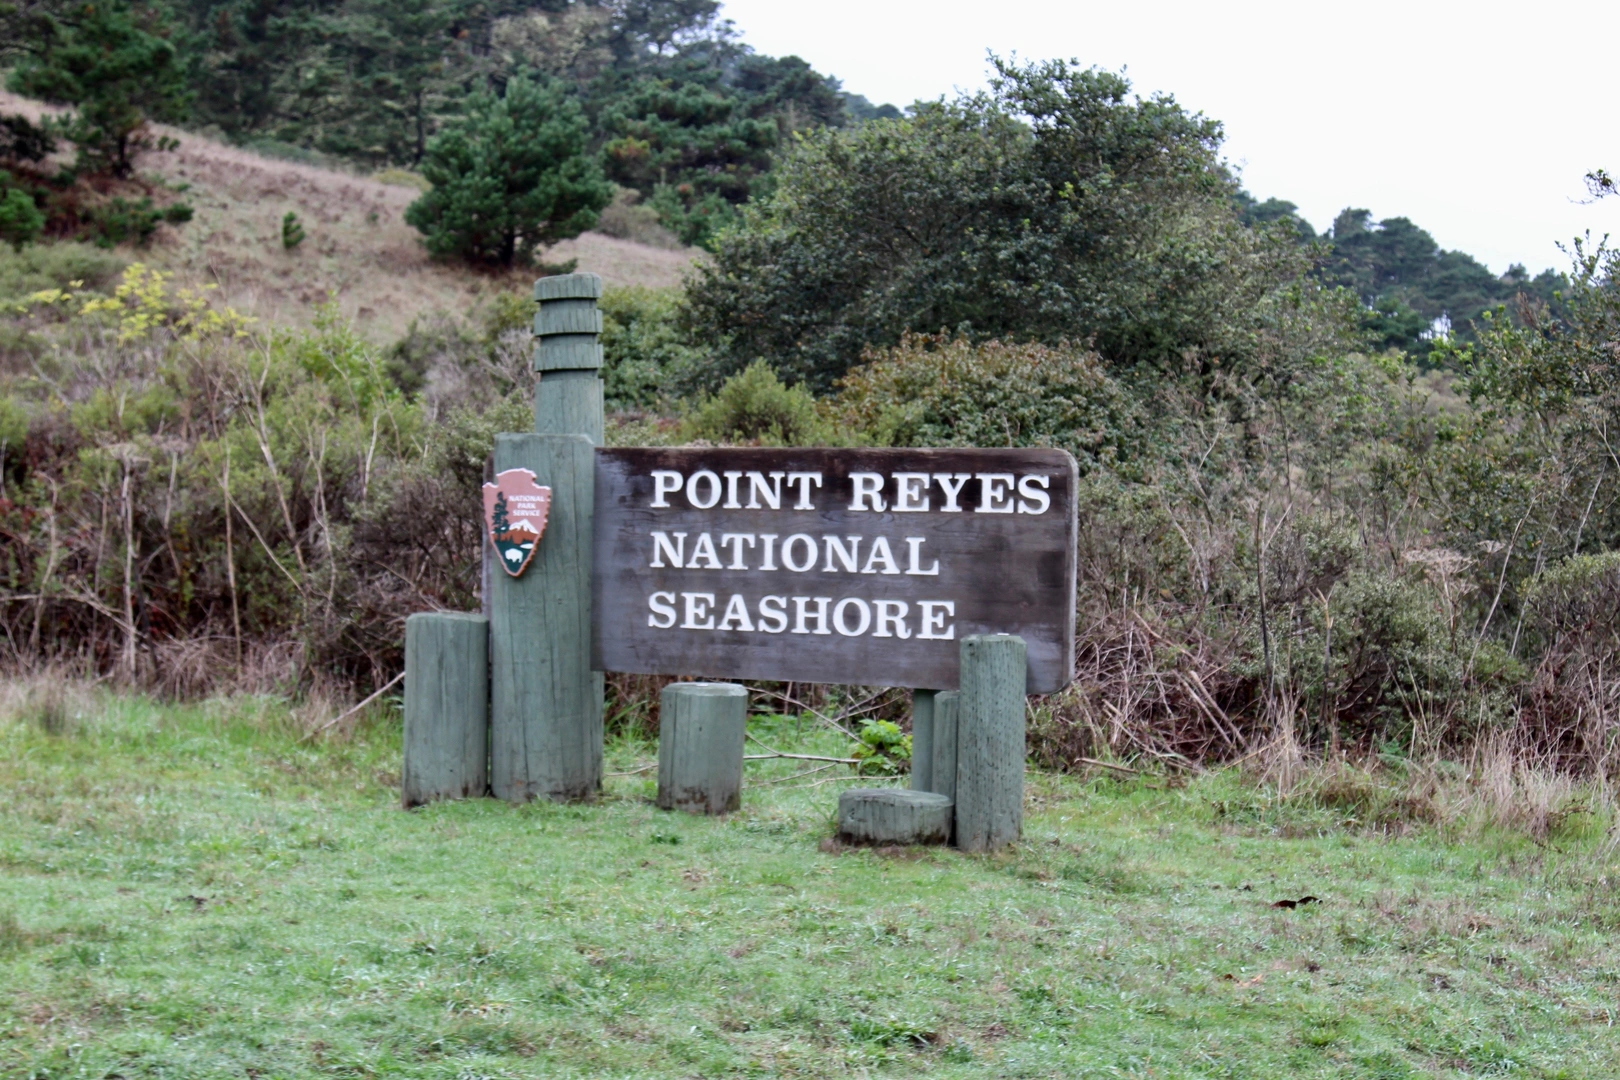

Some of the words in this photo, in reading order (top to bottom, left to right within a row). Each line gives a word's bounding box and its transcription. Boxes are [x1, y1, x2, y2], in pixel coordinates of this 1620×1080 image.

[650, 470, 822, 511] POINT
[847, 472, 1051, 515] REYES
[650, 531, 939, 576] NATIONAL
[648, 591, 955, 640] SEASHORE
